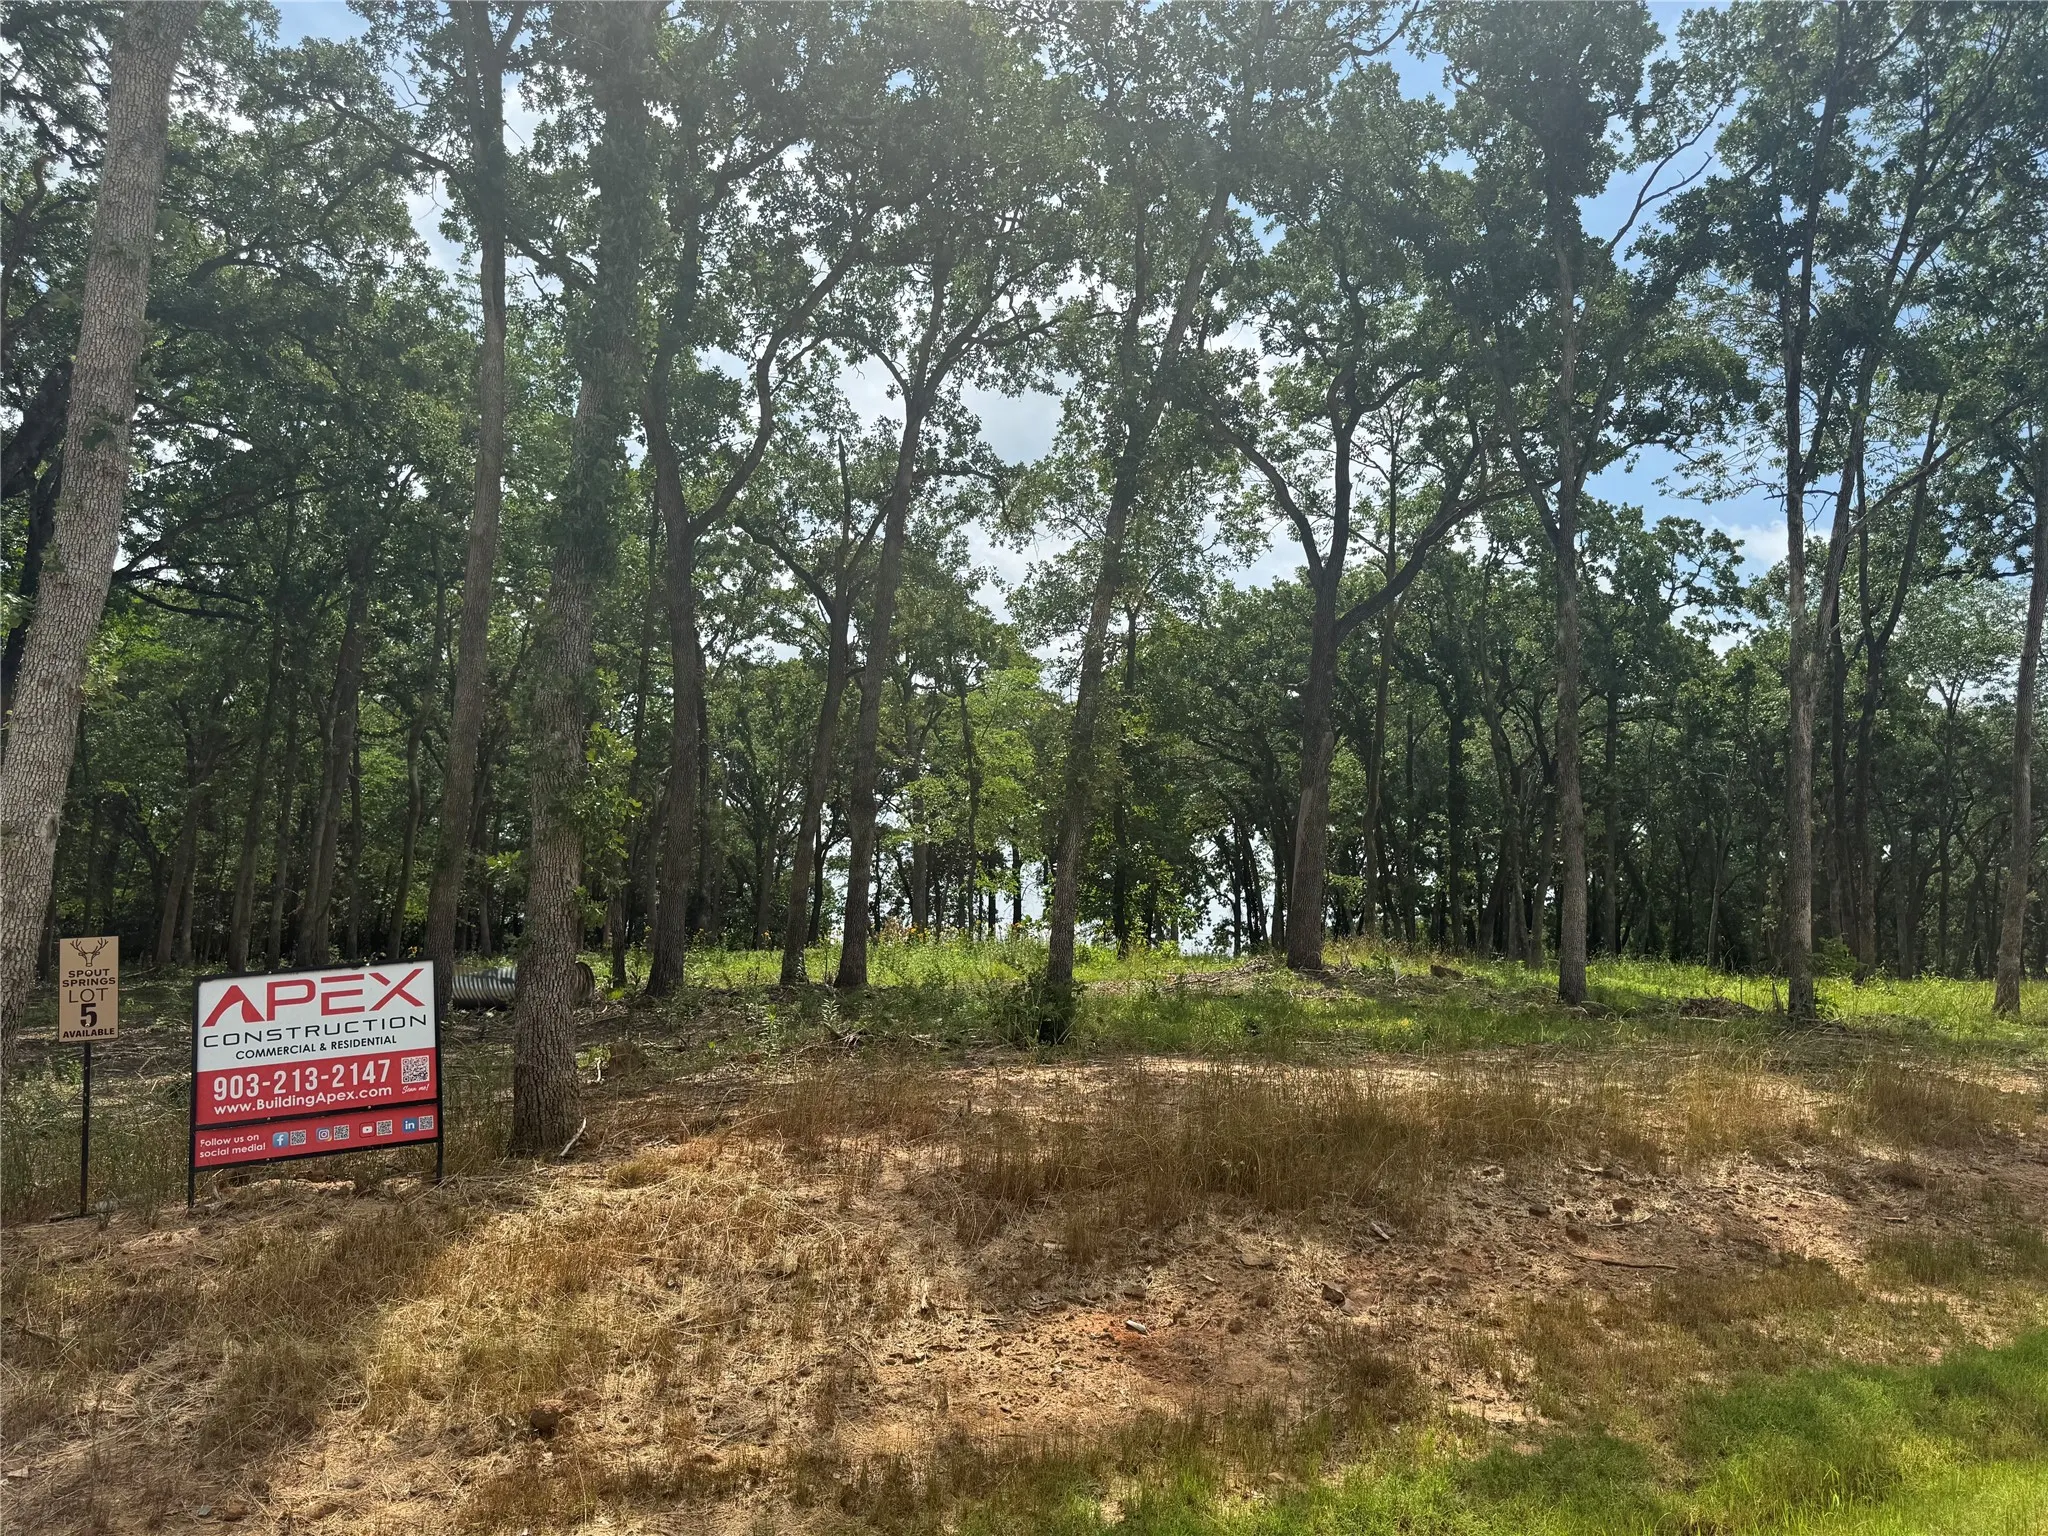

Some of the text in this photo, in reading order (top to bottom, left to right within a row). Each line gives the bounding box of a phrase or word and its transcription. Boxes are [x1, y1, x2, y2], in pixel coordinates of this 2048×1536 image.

[62, 977, 116, 988] SPRINGS
[68, 968, 110, 978] SPOUT
[69, 988, 108, 1003] LOT
[202, 968, 425, 1028] APEX
[80, 1003, 97, 1028] 5
[63, 1027, 115, 1038] AVAILABLE
[203, 1014, 426, 1048] CONSTRUCTION
[235, 1035, 397, 1060] COMMERCIAL & RESIDENTIAL
[213, 1059, 391, 1101] 903-213-2147
[214, 1086, 392, 1115] www.BuildingApex.com
[199, 1142, 266, 1158] social media!
[200, 1137, 231, 1148] Follow
[234, 1135, 244, 1143] us
